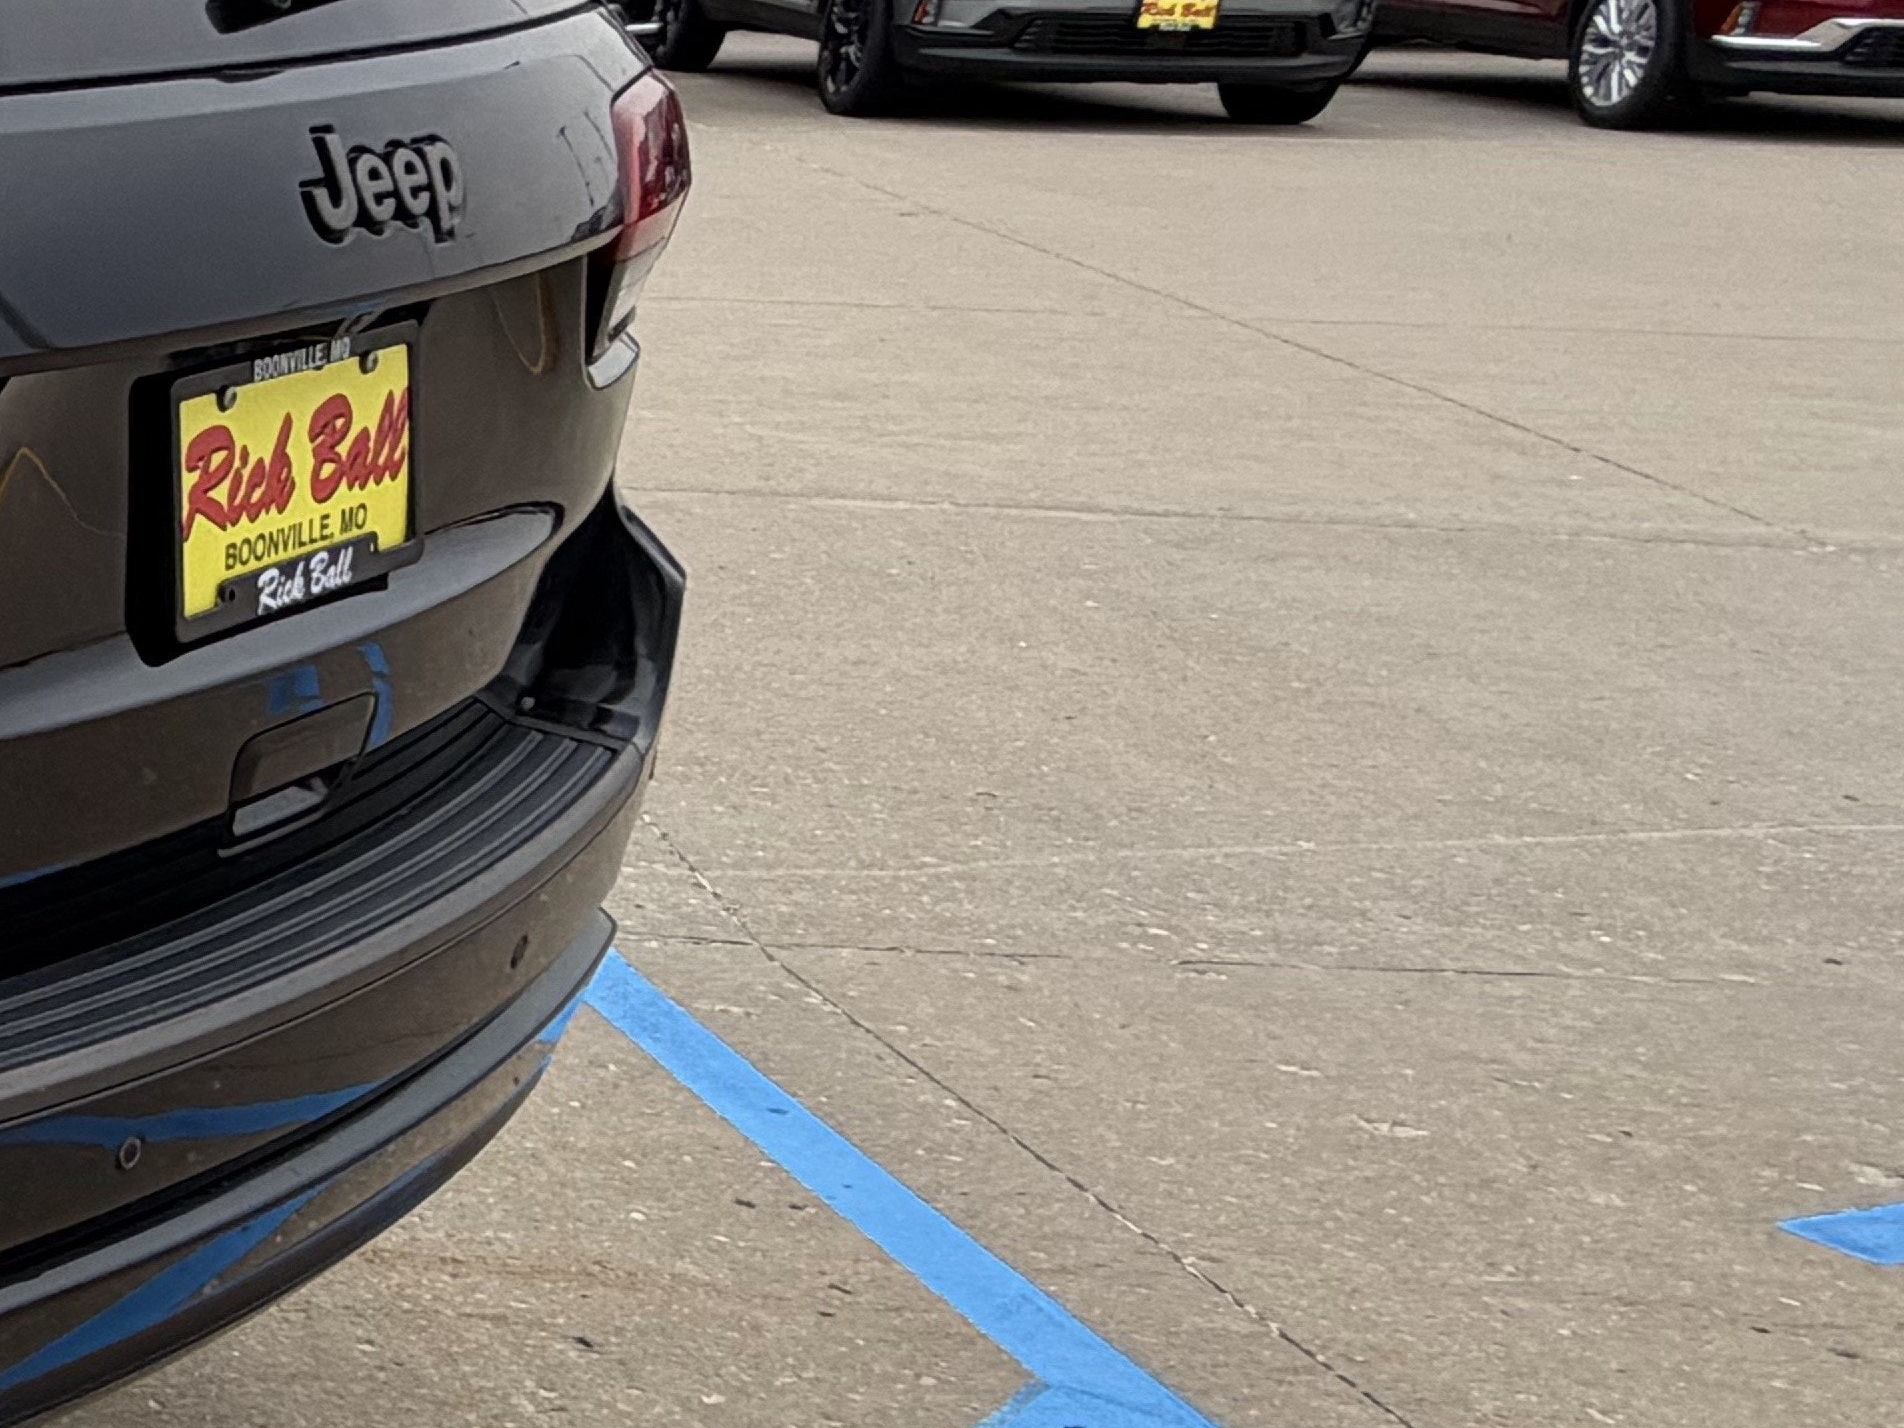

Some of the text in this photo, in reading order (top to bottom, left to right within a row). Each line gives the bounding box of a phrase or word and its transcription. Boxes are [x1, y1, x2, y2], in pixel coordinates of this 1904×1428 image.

[299, 124, 465, 244] Jeep
[331, 337, 351, 362] MO
[181, 387, 411, 543] Rick Ball
[224, 503, 368, 571] BOONVILLE, MO
[256, 546, 354, 616] Rick Ball
